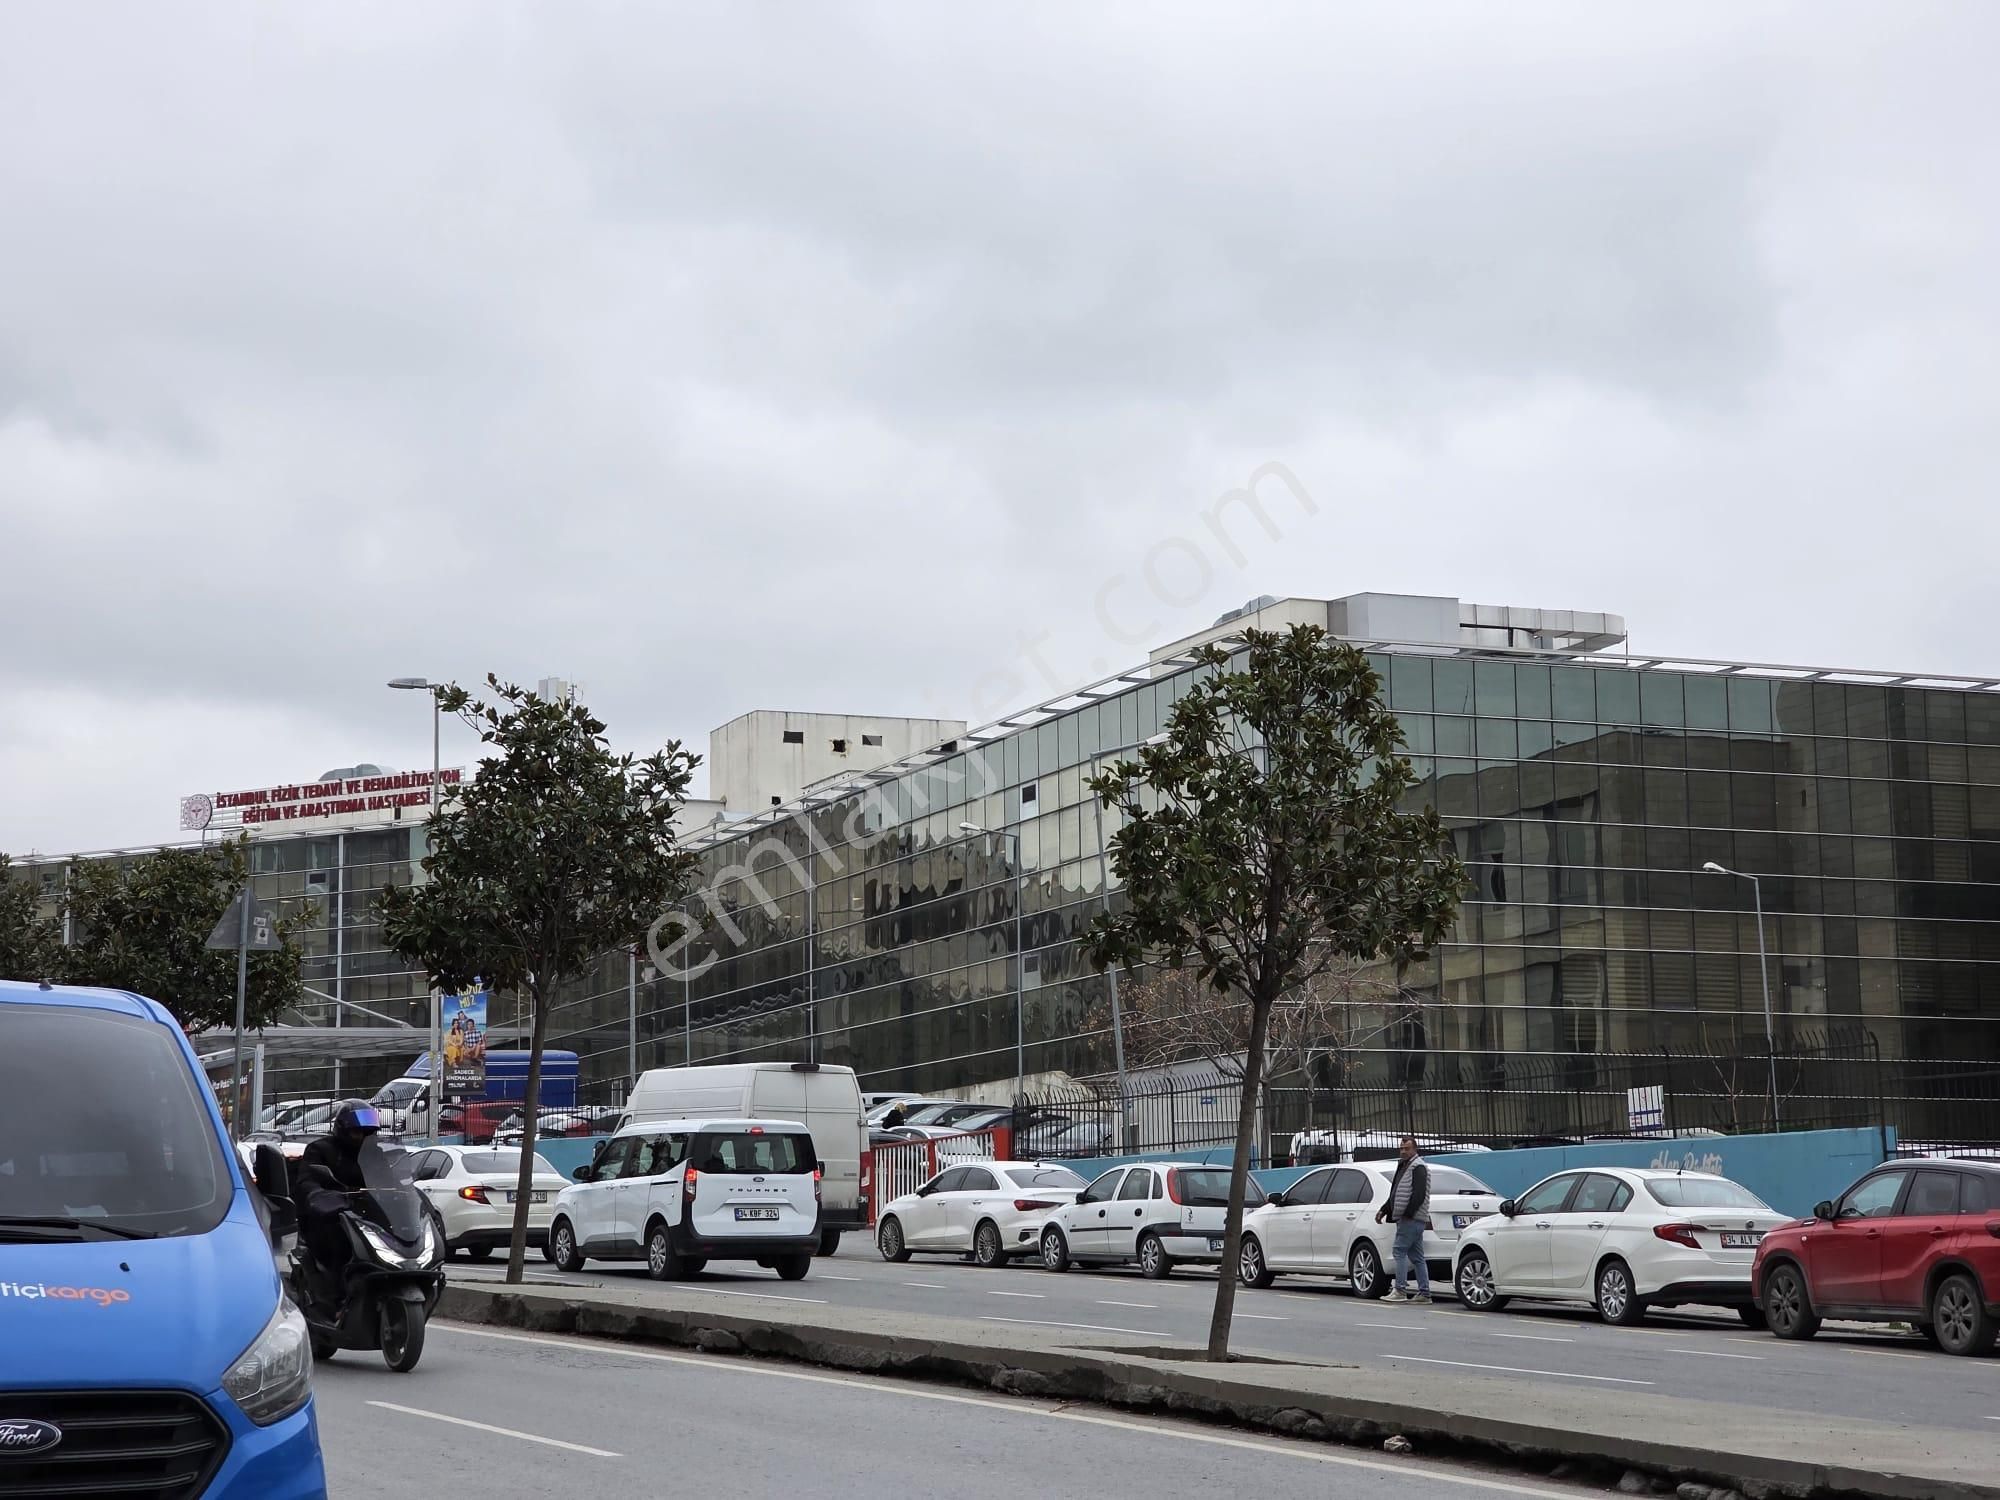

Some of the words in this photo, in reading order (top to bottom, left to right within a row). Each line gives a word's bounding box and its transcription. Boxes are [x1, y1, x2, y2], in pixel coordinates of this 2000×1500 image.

[216, 792, 269, 808] İSTANBUL
[271, 784, 300, 802] FİZİK
[302, 778, 343, 798] TEDAVİ
[346, 780, 361, 794] VE
[363, 769, 460, 793] REHABİLİTASYON
[242, 804, 281, 824] EĞİTİM
[282, 805, 297, 819] VE
[298, 797, 366, 818] ARAŞTIRMA
[368, 787, 430, 809] HASTANESİ
[738, 1209, 748, 1218] 34
[765, 1209, 778, 1218] 324
[1727, 1235, 1736, 1244] 34
[1740, 1235, 1753, 1245] ALV
[0, 1424, 42, 1445] Ford
